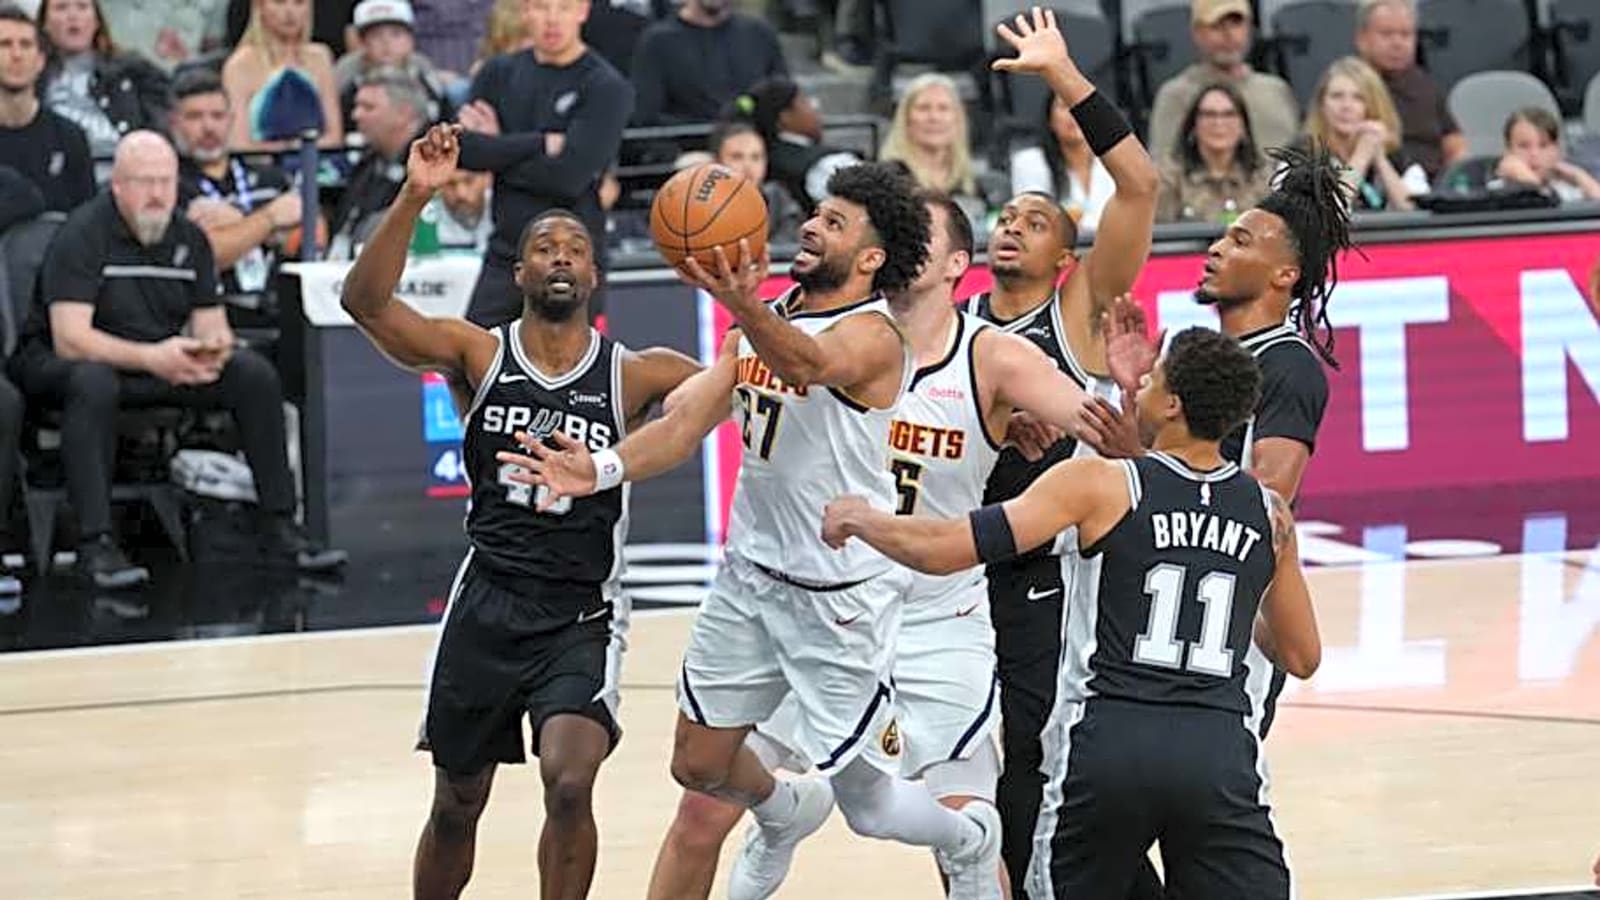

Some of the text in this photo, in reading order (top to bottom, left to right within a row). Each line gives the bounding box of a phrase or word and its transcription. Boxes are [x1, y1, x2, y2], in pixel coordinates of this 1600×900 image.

[888, 420, 965, 460] GETS
[1152, 511, 1261, 561] BRYANT
[1132, 562, 1237, 678] 11
